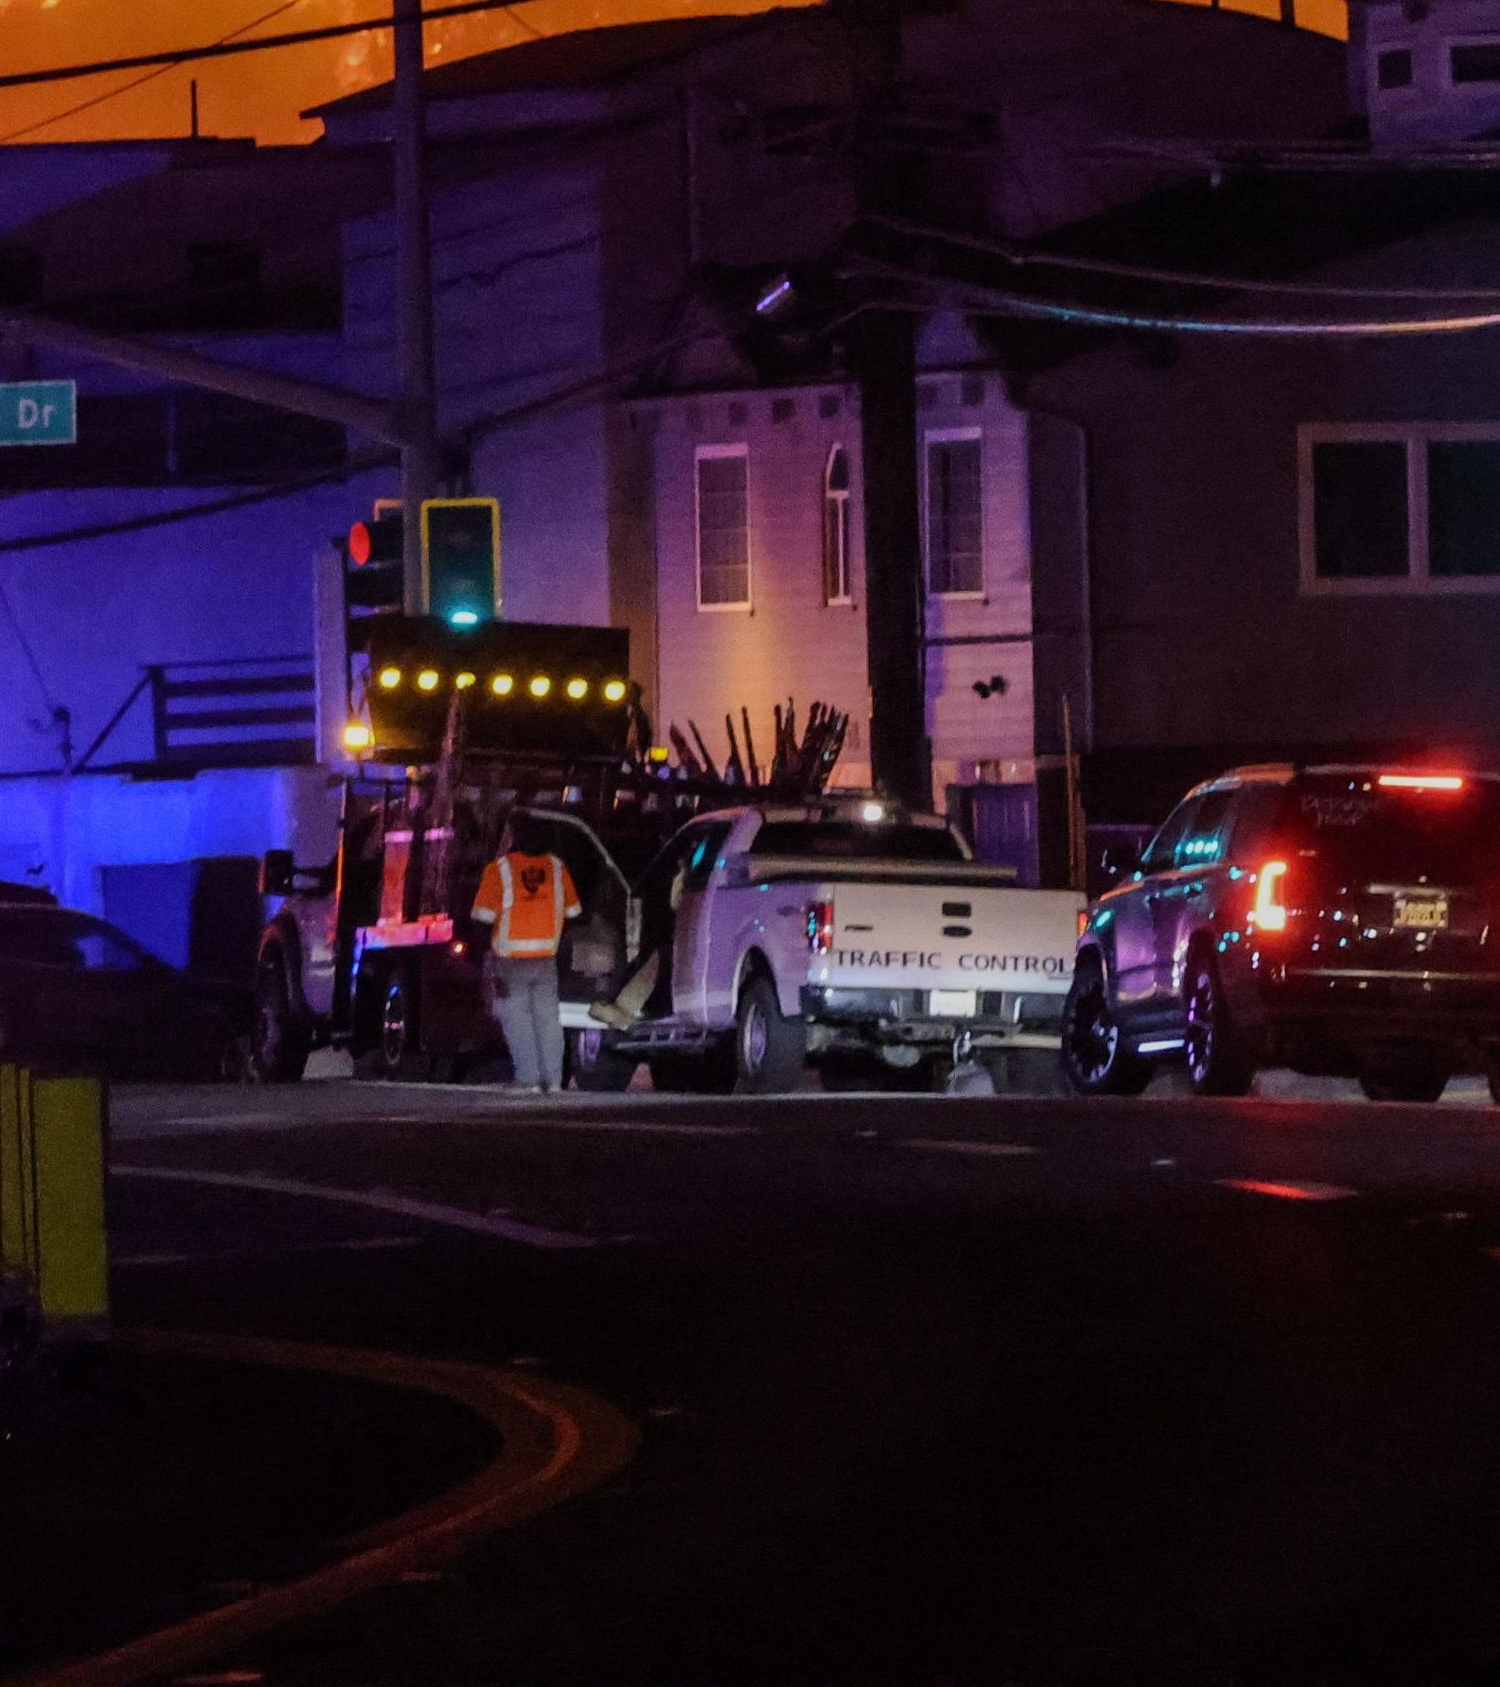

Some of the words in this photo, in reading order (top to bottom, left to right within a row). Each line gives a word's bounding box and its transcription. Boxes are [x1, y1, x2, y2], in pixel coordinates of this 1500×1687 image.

[18, 398, 54, 429] Dr
[836, 950, 942, 969] TRAFFIC
[959, 953, 1072, 974] CONTROL
